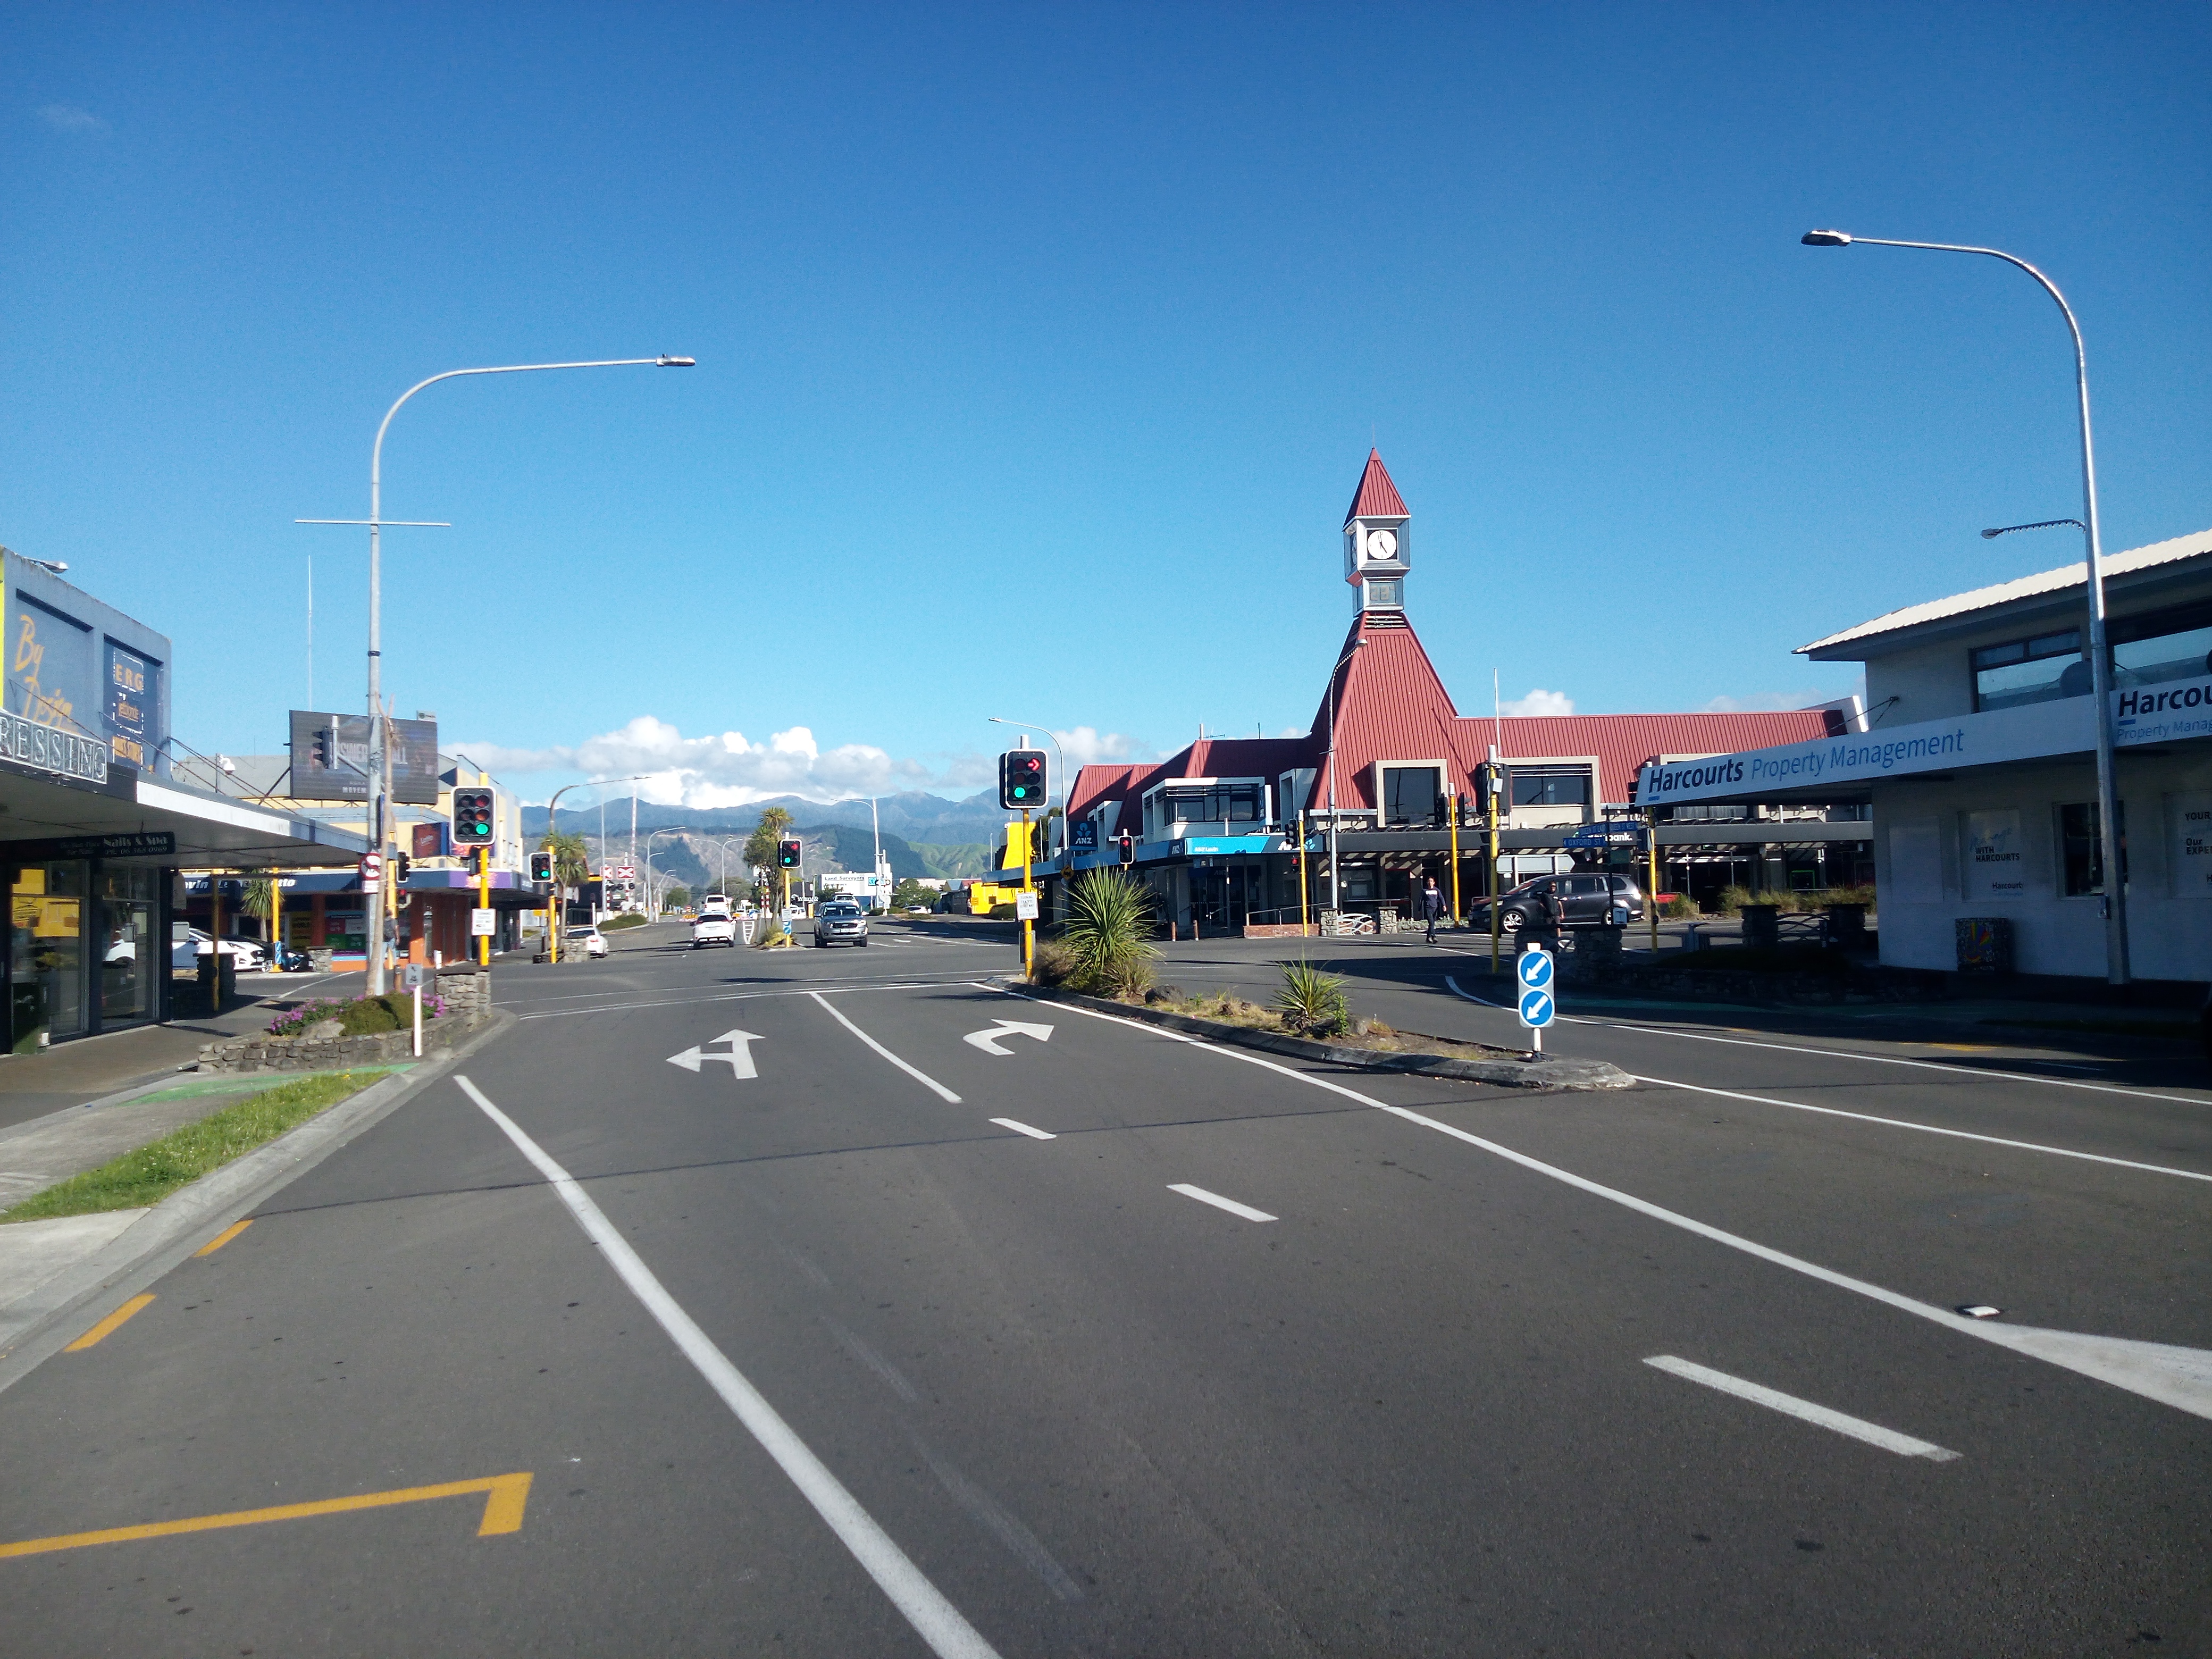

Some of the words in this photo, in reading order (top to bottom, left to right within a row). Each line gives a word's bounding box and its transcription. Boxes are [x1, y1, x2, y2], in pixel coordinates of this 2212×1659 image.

[2118, 724, 2169, 741] Property
[1648, 758, 1744, 793] Harcourts
[1752, 751, 1826, 782] Property
[1830, 728, 1964, 769] Management
[1976, 853, 2020, 862] HARCOURTS
